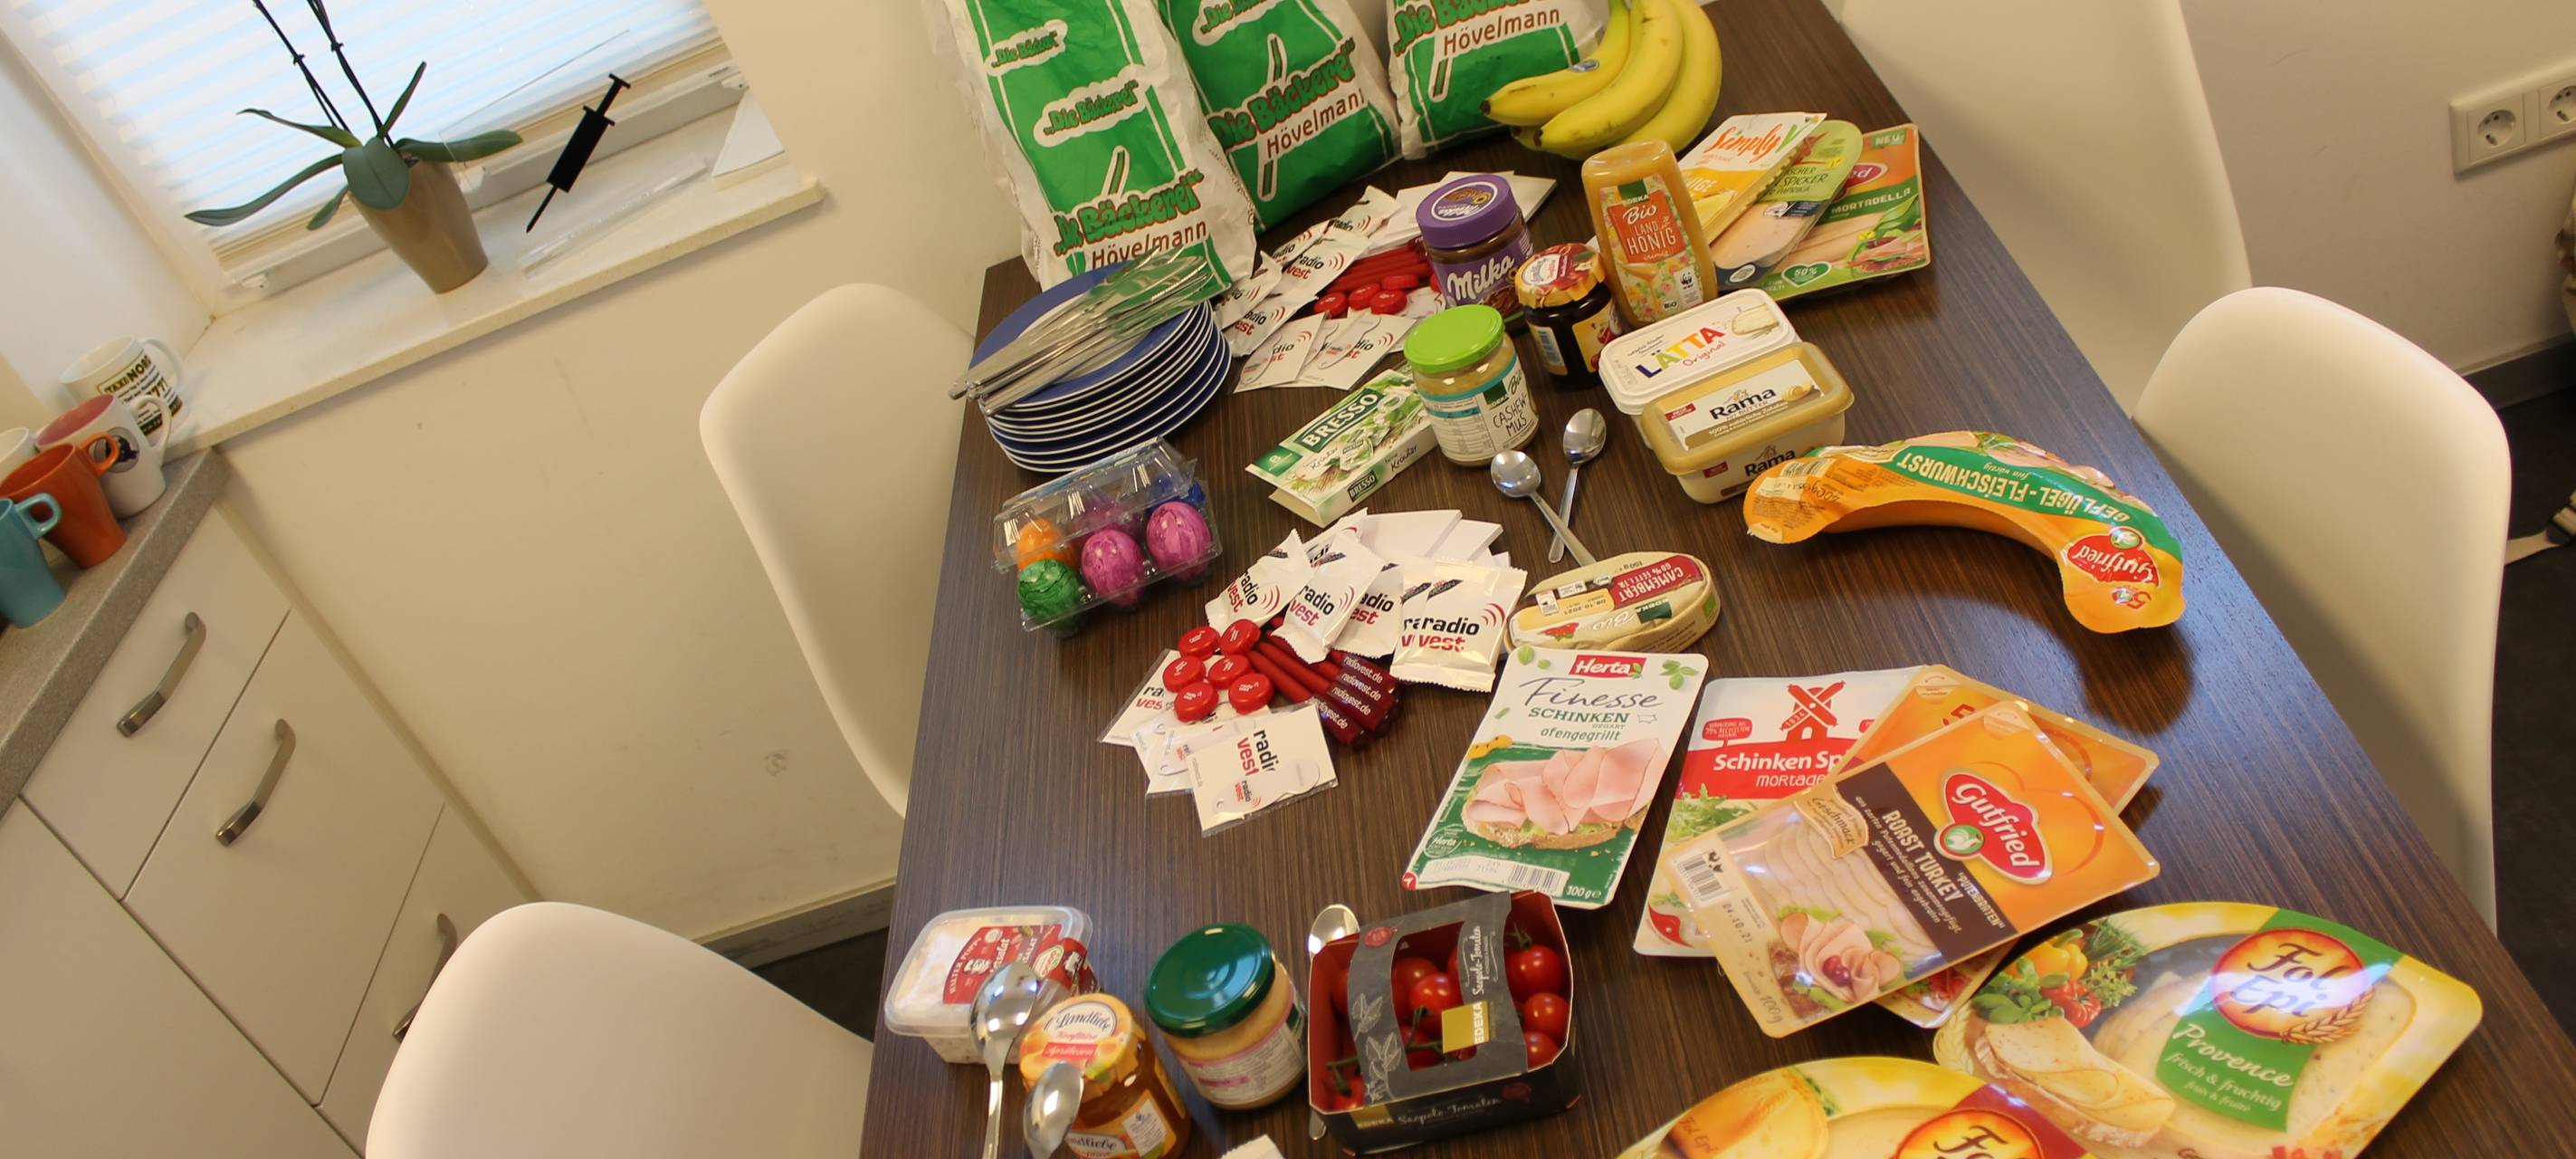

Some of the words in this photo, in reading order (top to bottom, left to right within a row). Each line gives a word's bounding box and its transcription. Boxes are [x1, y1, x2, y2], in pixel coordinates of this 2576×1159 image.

[1444, 8, 1560, 56] Hövelmann
[1703, 122, 1783, 163] Simply
[1875, 132, 1901, 146] NEU
[1623, 205, 1657, 225] Bio
[1831, 186, 1912, 214] MORTADELLA
[1627, 227, 1677, 255] HONIG
[1634, 221, 1659, 236] LAND
[1092, 221, 1207, 269] Hövelmann
[1447, 254, 1516, 301] Milka
[1636, 327, 1726, 378] LÄTTA
[1682, 340, 1726, 368] Original
[1301, 392, 1380, 446] BRESSO
[1710, 388, 1777, 420] Rama
[1505, 412, 1528, 436] MUS
[1744, 450, 1797, 476] Rama
[1349, 474, 1376, 498] BRESSO
[2074, 542, 2157, 587] Gutfried
[1619, 566, 1684, 603] CAMEMBERT
[1289, 598, 1320, 627] vest
[1421, 617, 1480, 636] radio
[1418, 634, 1465, 652] vest
[1575, 658, 1632, 675] Herta
[1136, 698, 1163, 711] ves
[1519, 677, 1665, 709] Finesse
[1528, 706, 1630, 724] SCHINKEN
[1541, 726, 1622, 742] ofengegrillt
[1713, 752, 1812, 771] Schinken
[1951, 782, 2040, 868] Gutfried
[1882, 809, 1924, 855] ROAST
[1914, 852, 1963, 903] TURKEY
[2247, 943, 2352, 991] Fol
[2230, 974, 2328, 1018] Epi
[1474, 1001, 1483, 1045] EDEKA
[2172, 1021, 2294, 1087] Provence
[2165, 1050, 2209, 1082] frisch
[2219, 1078, 2284, 1112] fruchtig
